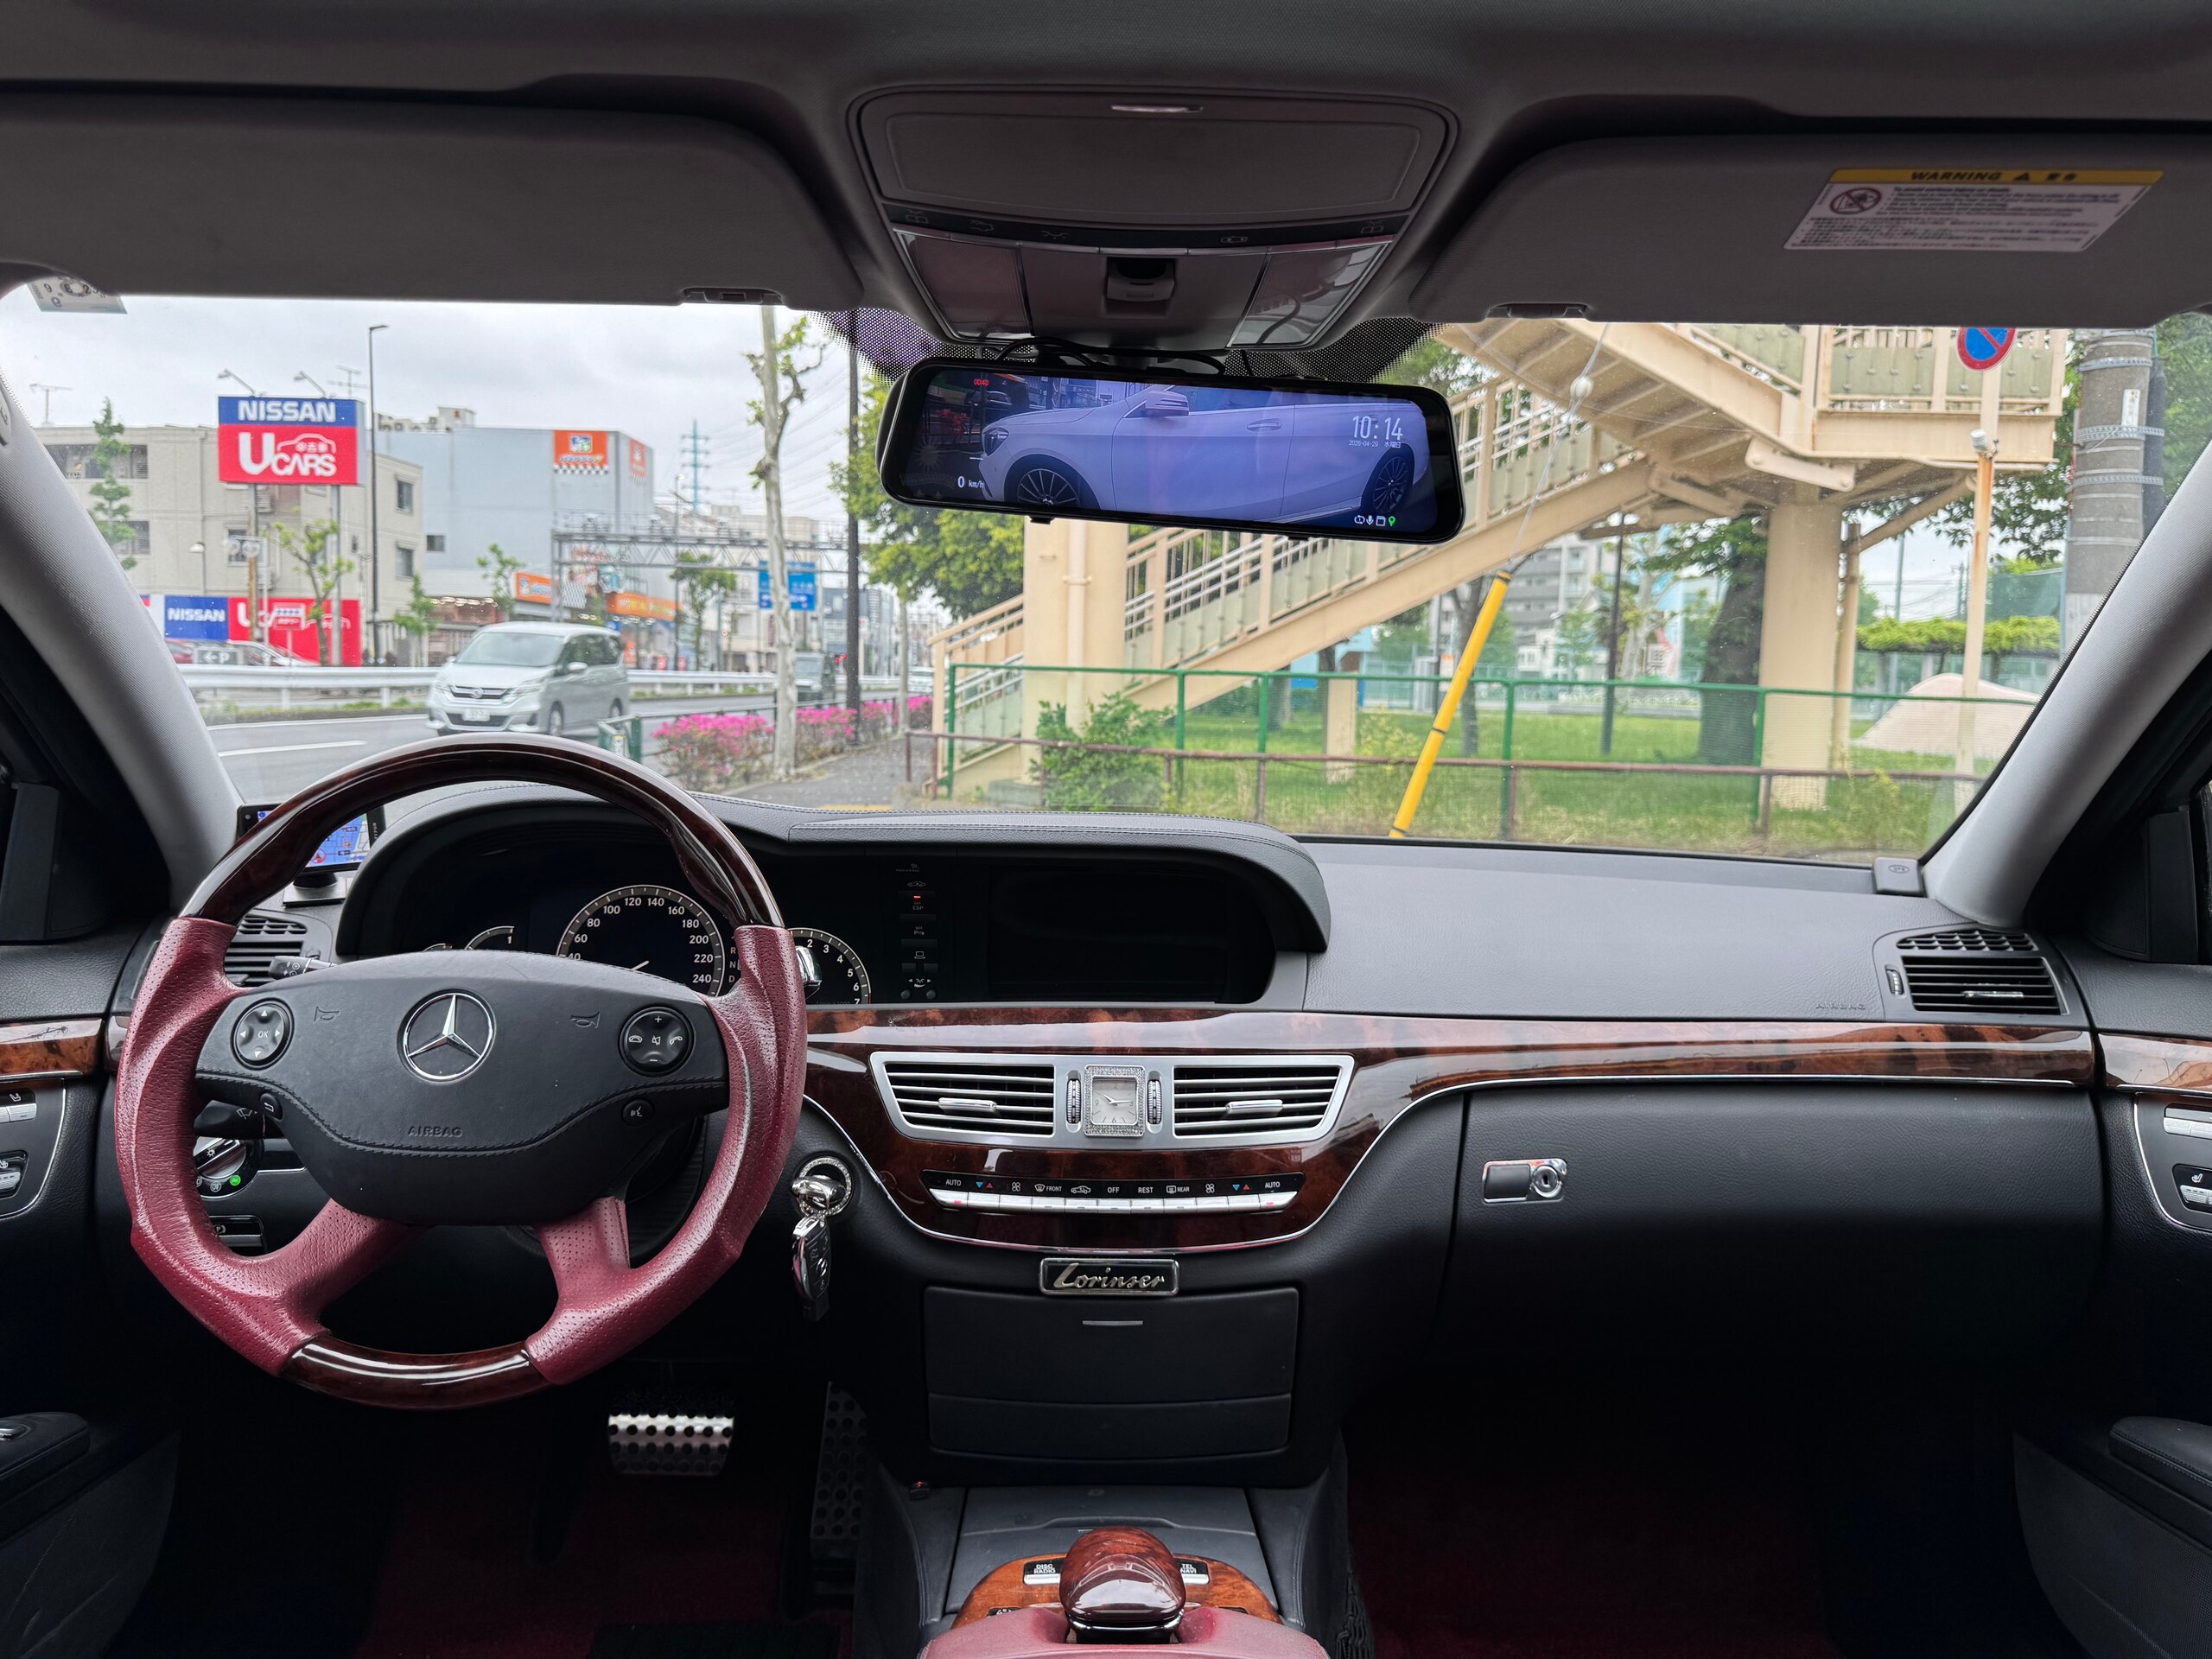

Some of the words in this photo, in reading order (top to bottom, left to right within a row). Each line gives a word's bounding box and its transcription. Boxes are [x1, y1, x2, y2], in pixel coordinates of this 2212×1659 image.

[1910, 172, 2002, 181] WARNING
[238, 400, 336, 423] NISSAN
[1352, 416, 1403, 441] 10:14
[957, 476, 965, 488] 0
[969, 480, 984, 488] km/h
[168, 608, 226, 622] NISSAN
[624, 897, 642, 906] 120
[647, 897, 664, 906] 140
[603, 906, 620, 915] 100
[668, 906, 685, 915] 160
[587, 918, 601, 928] 80
[682, 918, 700, 929] 180
[506, 936, 512, 944] 1
[574, 933, 588, 944] 60
[689, 935, 709, 944] 200
[807, 939, 813, 948] 2
[823, 944, 830, 953] 3
[568, 952, 582, 961] 40
[694, 954, 714, 963] 220
[836, 955, 843, 963] 4
[847, 969, 854, 977] 5
[692, 974, 712, 983] 240
[853, 982, 860, 991] 6
[408, 1126, 463, 1138] AIRBAG
[1053, 1262, 1165, 1288] Lorinser
